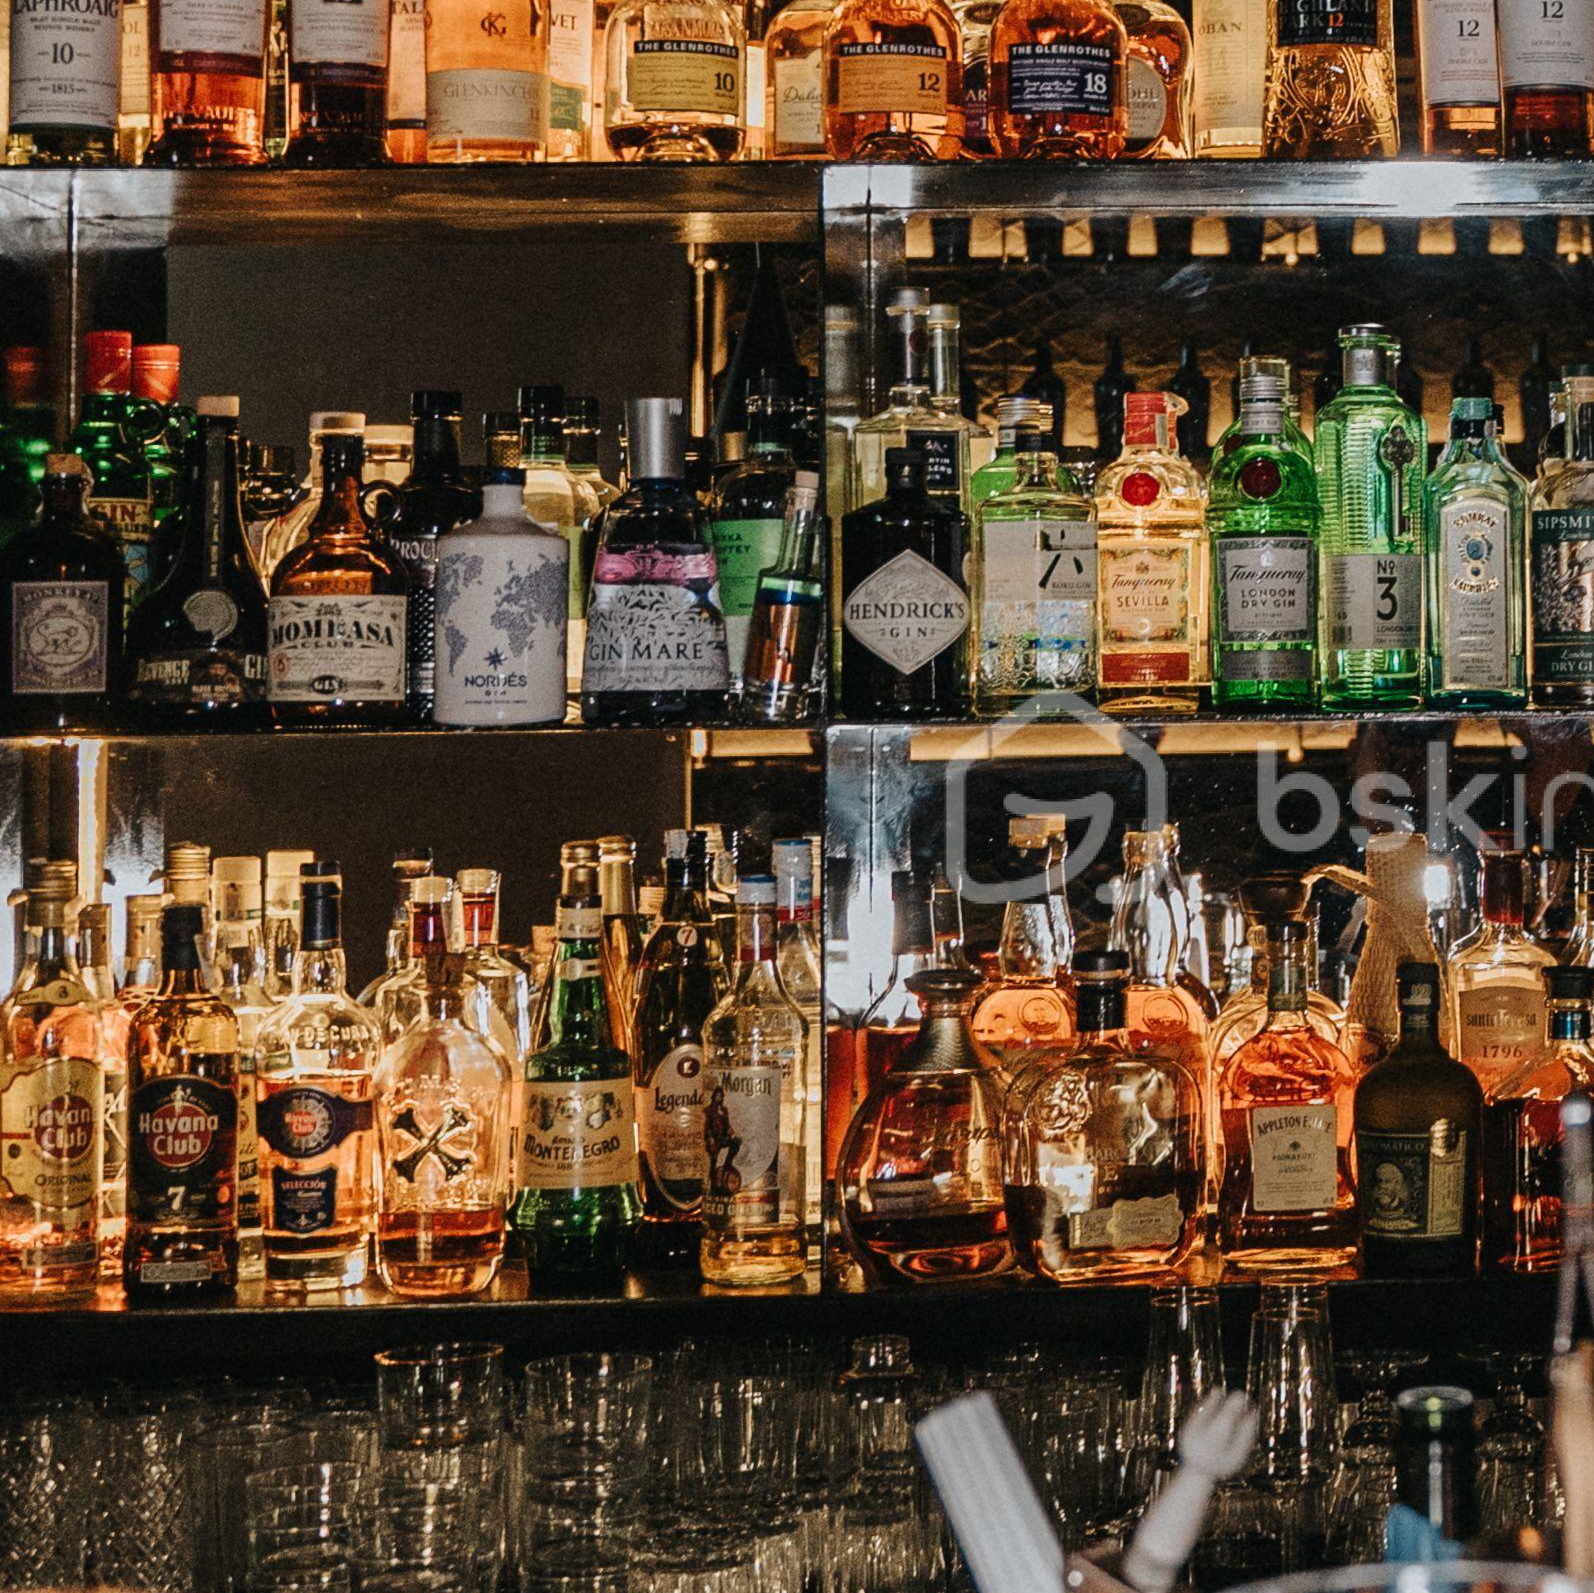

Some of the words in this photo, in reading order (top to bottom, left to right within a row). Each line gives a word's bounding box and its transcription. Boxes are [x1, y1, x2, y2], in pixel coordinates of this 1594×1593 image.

[1540, 0, 1565, 20] 12
[1198, 21, 1245, 37] OBAN
[1328, 14, 1345, 29] 12
[1457, 19, 1481, 39] 12
[51, 42, 74, 65] 10
[637, 41, 661, 53] THE
[663, 40, 739, 58] GLENROTHES
[842, 43, 869, 56] THE
[872, 43, 946, 57] GLENROTHES
[1011, 43, 1035, 56] THE
[1038, 43, 1111, 58] GLENROTHES
[714, 71, 735, 94] 10
[917, 73, 941, 94] 12
[1083, 71, 1109, 95] 18
[1111, 573, 1177, 591] Tanqueray
[1229, 564, 1306, 584] Tanqueray
[1116, 595, 1170, 608] SEVILLA
[1241, 587, 1297, 599] LONDON
[1376, 576, 1398, 621] 3
[850, 602, 966, 621] HENDRICK'S
[1241, 598, 1271, 609] DRY
[1273, 598, 1297, 609] GIN
[889, 627, 929, 638] GIN
[590, 644, 623, 661] GIN
[631, 642, 704, 660] MARE
[138, 657, 191, 683] REVENGE
[1551, 661, 1576, 673] DRY
[464, 674, 528, 688] NORDÉS
[1481, 1045, 1524, 1059] 1796
[720, 1071, 773, 1097] Morgan
[139, 1112, 219, 1134] Havana
[1257, 1114, 1307, 1136] APPLETON
[41, 1127, 88, 1149] Club
[153, 1134, 202, 1156] Club
[167, 1186, 187, 1211] 7
